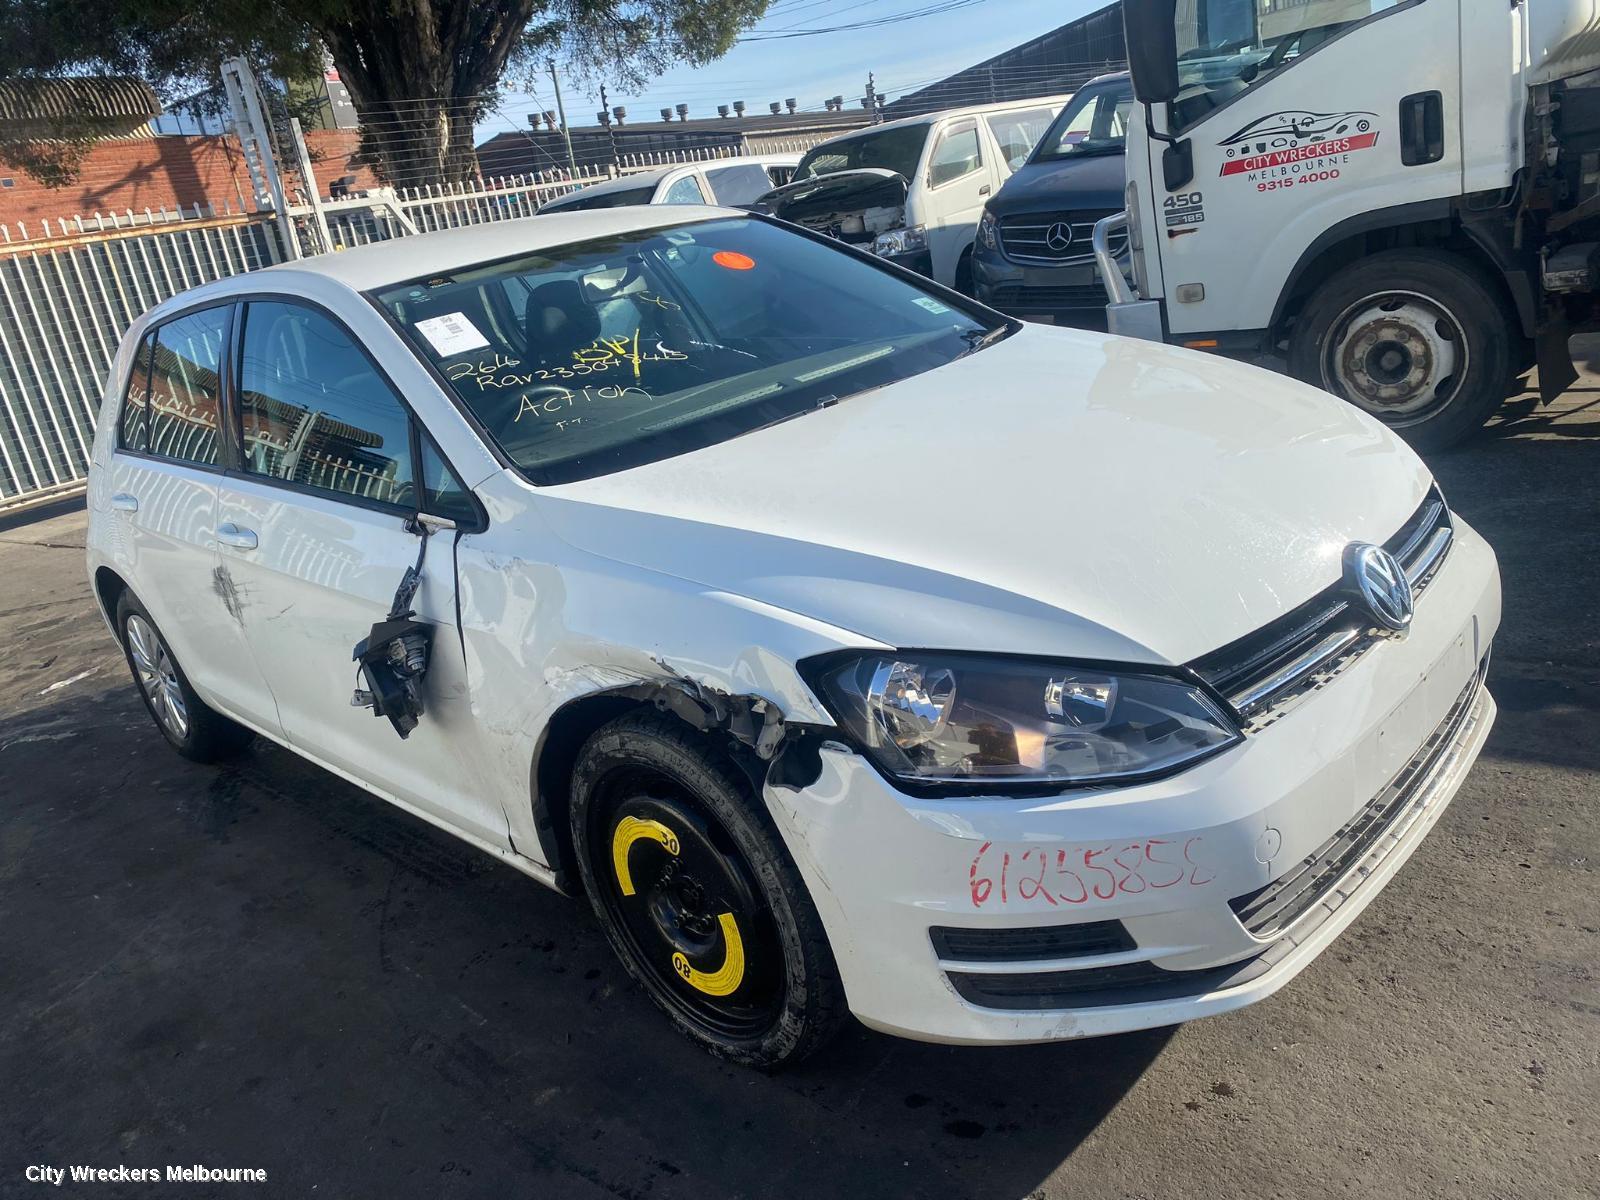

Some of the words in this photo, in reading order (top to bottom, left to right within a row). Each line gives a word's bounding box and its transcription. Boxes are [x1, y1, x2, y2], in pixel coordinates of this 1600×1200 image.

[1244, 155, 1273, 170] CITY
[1275, 138, 1350, 163] WRECKERS
[1248, 154, 1349, 182] MELBOURNE
[1257, 177, 1294, 192] 9315
[1298, 169, 1340, 184] 4000
[1163, 191, 1203, 208] 450
[1182, 213, 1203, 223] 185
